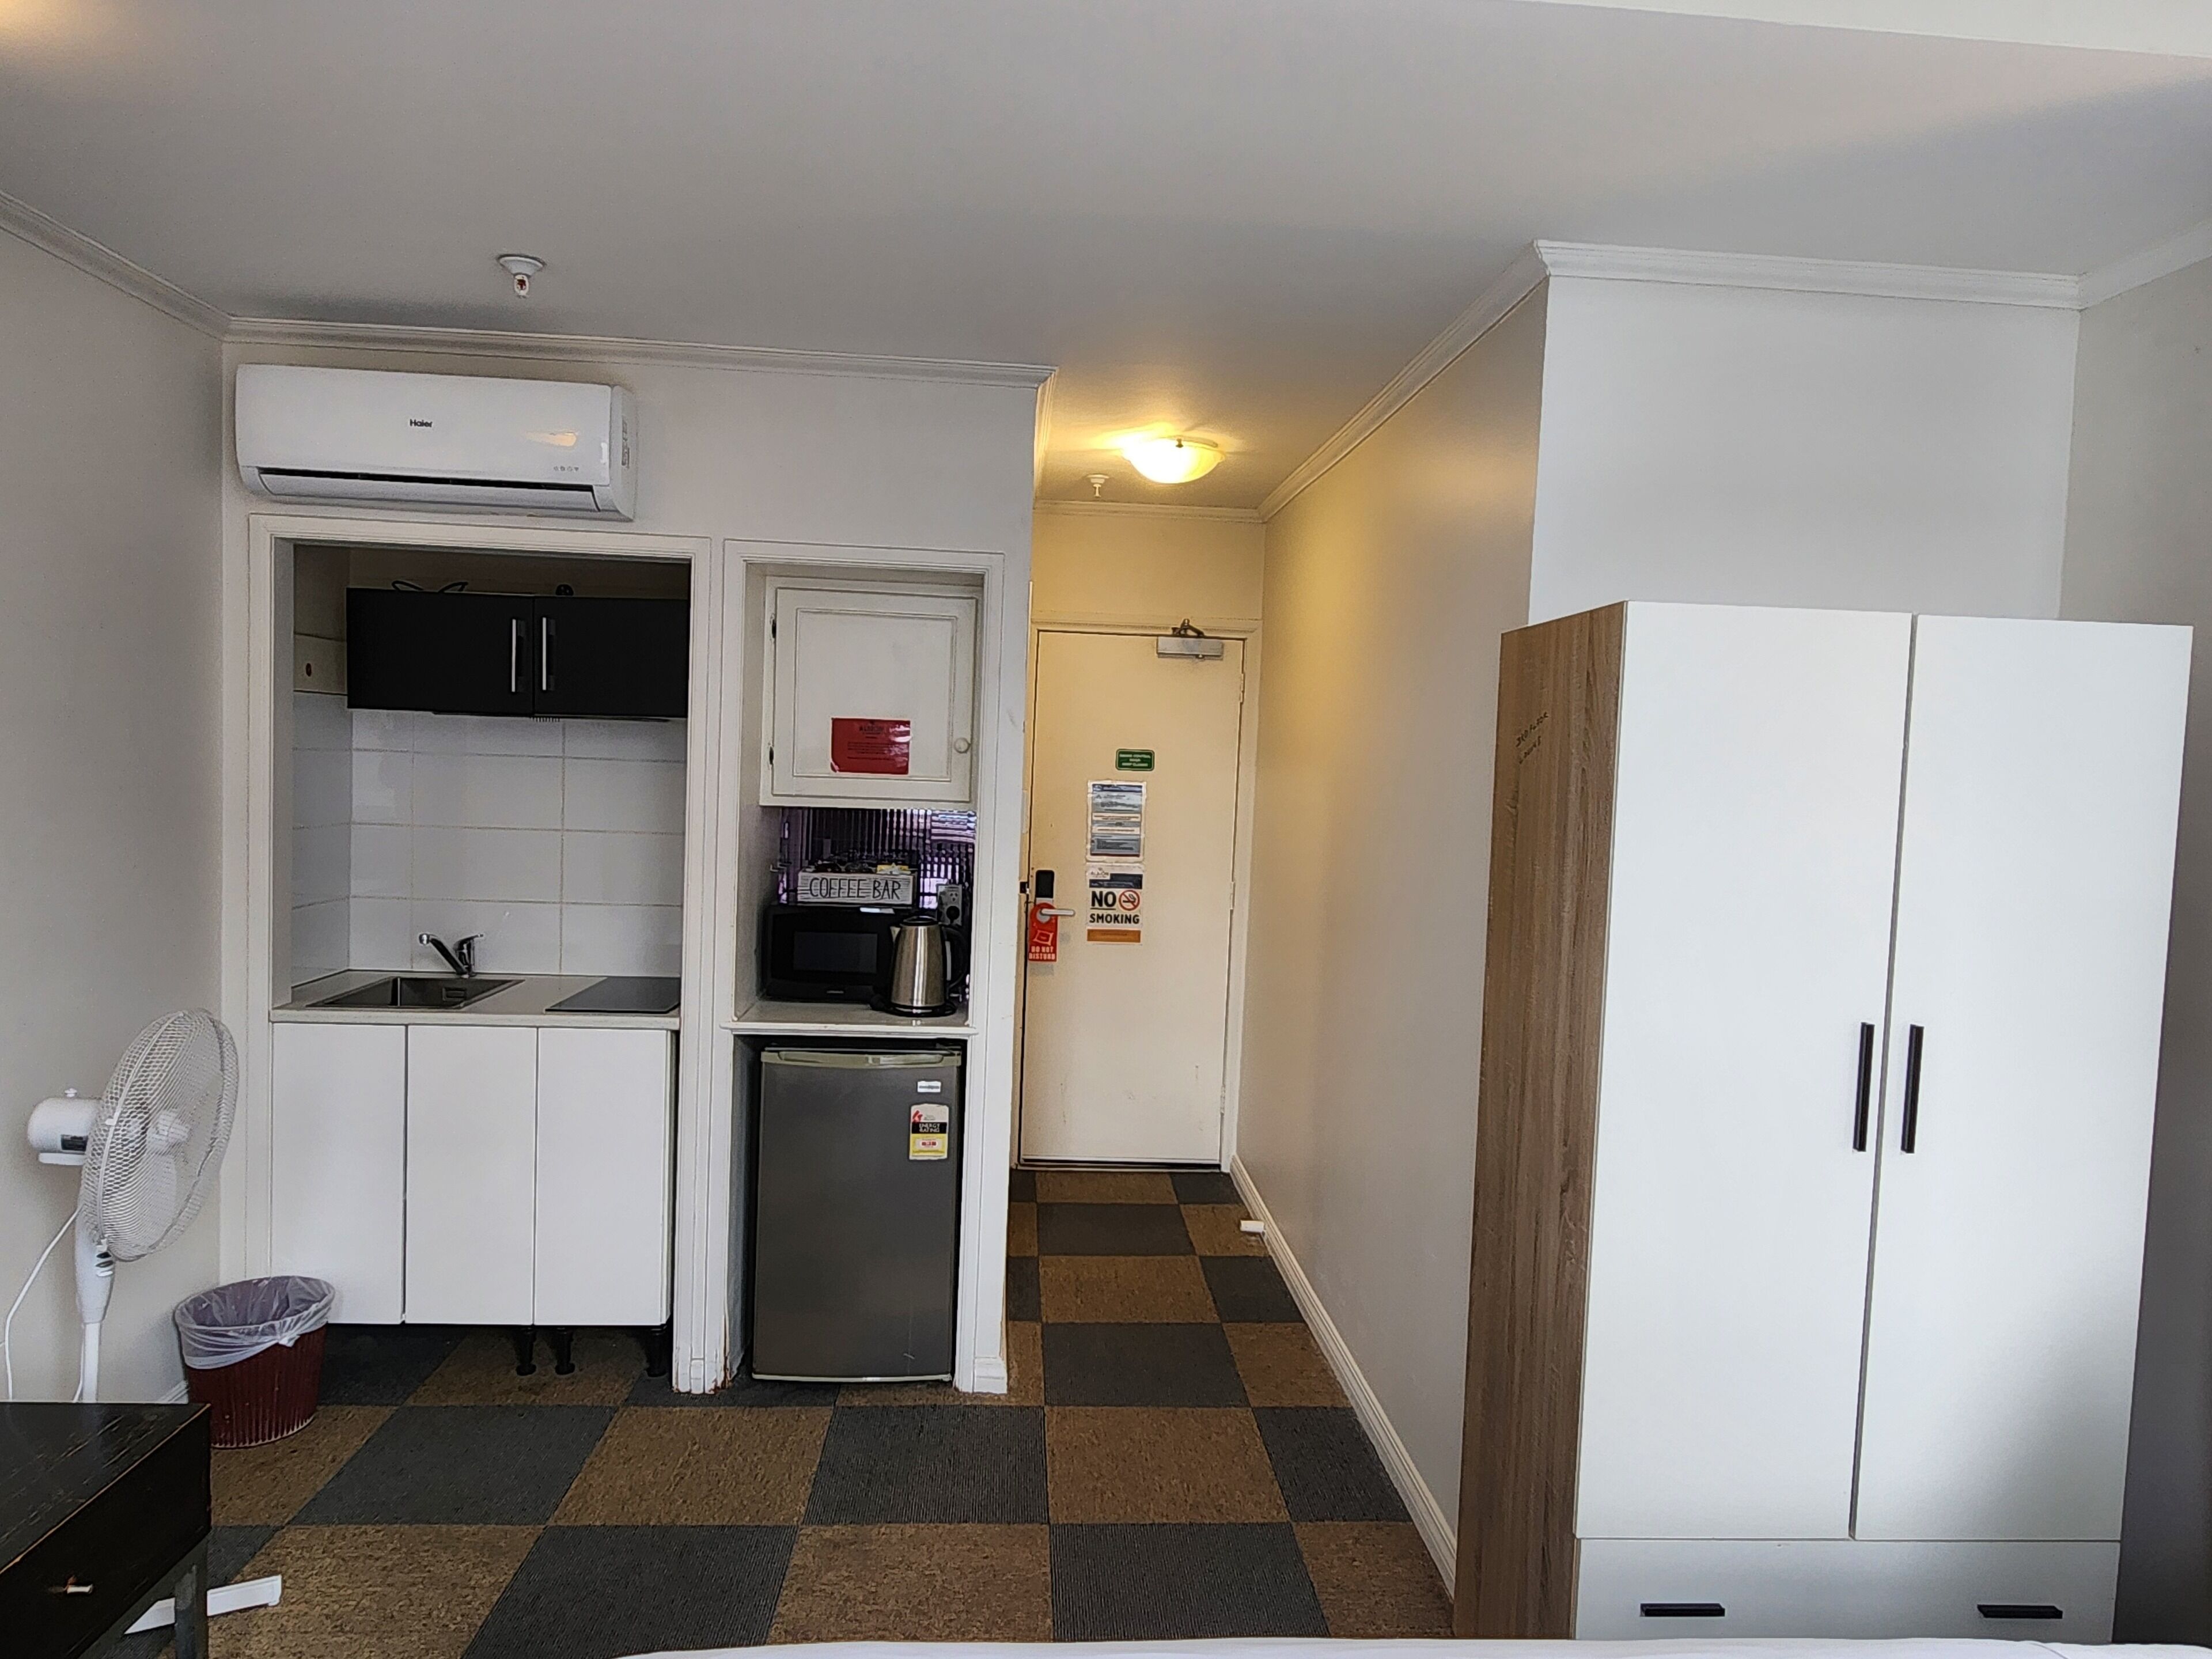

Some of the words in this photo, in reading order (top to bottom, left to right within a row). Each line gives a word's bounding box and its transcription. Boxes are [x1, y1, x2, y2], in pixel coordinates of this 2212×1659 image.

[410, 419, 433, 427] Haier
[809, 877, 866, 898] COFFEE
[872, 880, 902, 900] BAR
[1091, 891, 1116, 907] NO
[1089, 913, 1140, 925] SMOKING
